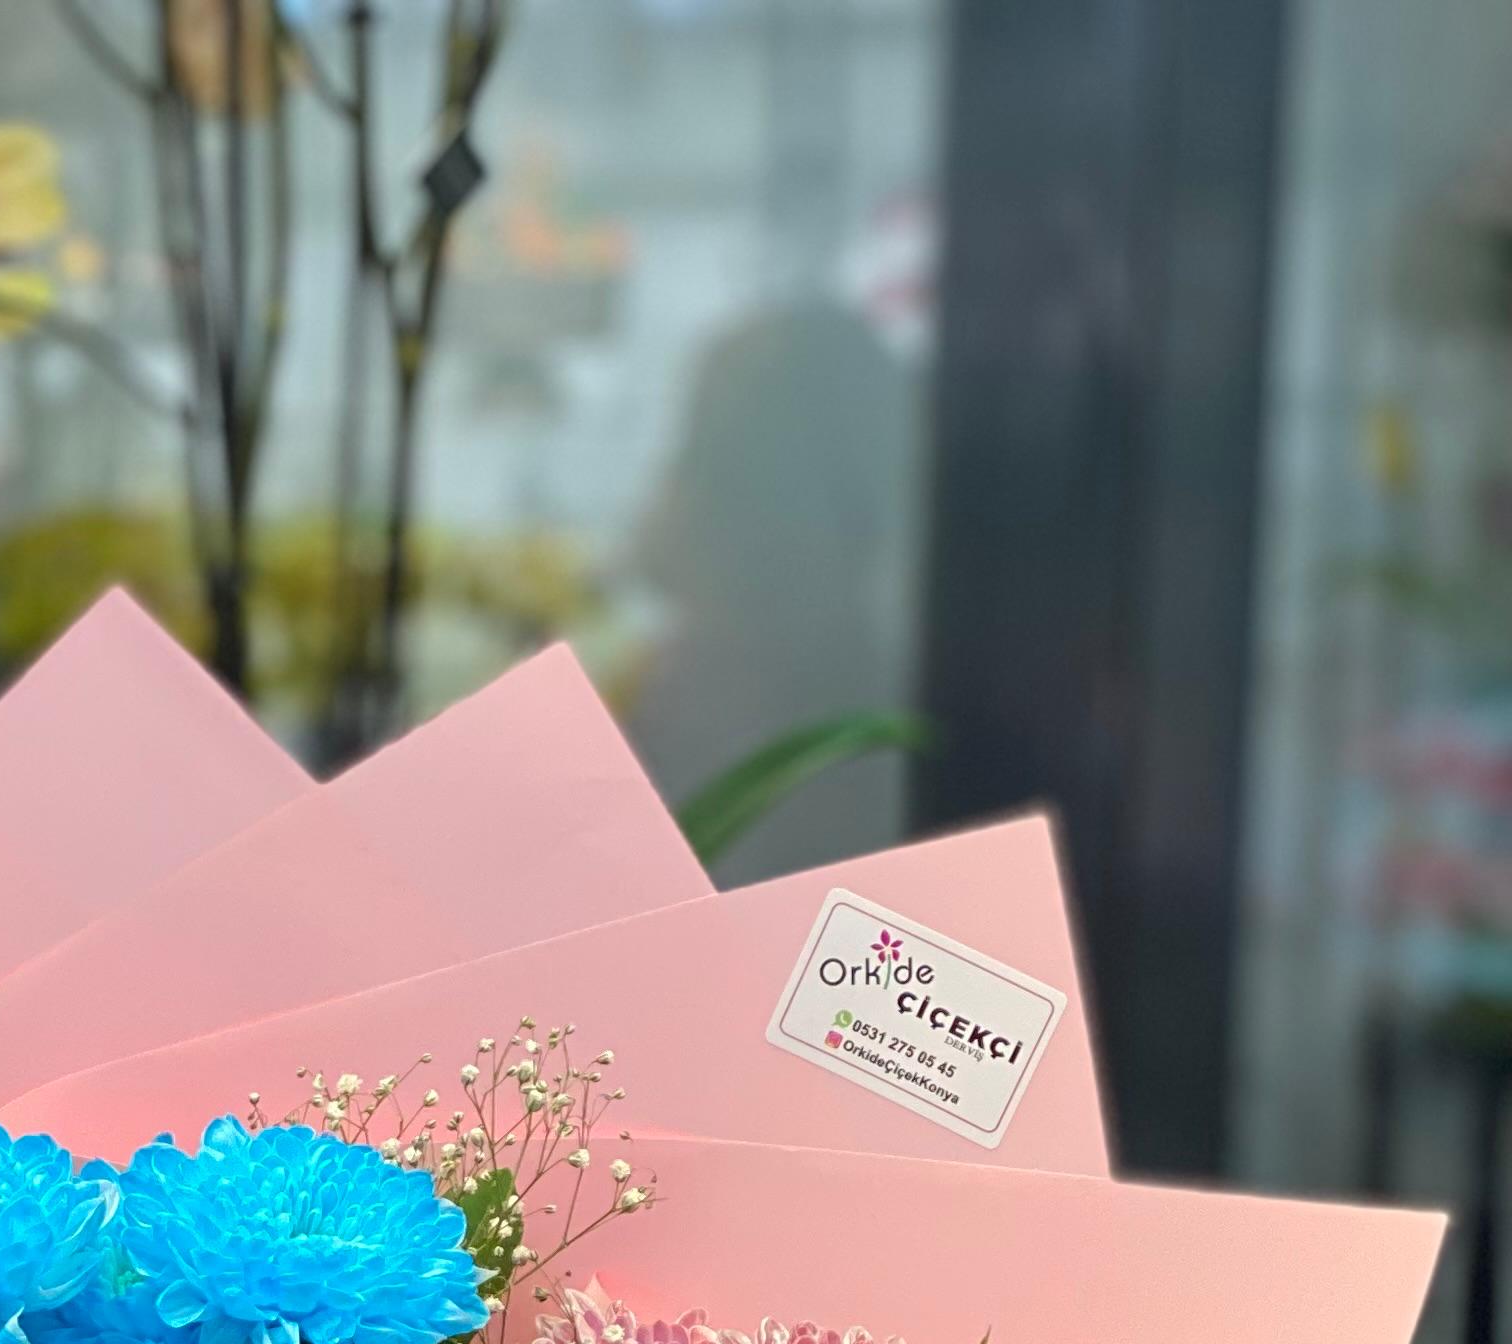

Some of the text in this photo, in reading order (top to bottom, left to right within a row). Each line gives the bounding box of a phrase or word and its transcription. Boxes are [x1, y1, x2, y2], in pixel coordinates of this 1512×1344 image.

[819, 954, 935, 990] Orkide
[852, 1019, 957, 1078] 0531 275 05 45
[897, 991, 1024, 1065] ÇİÇEKÇİ
[843, 1039, 960, 1105] OrkideÇiçekKonya
